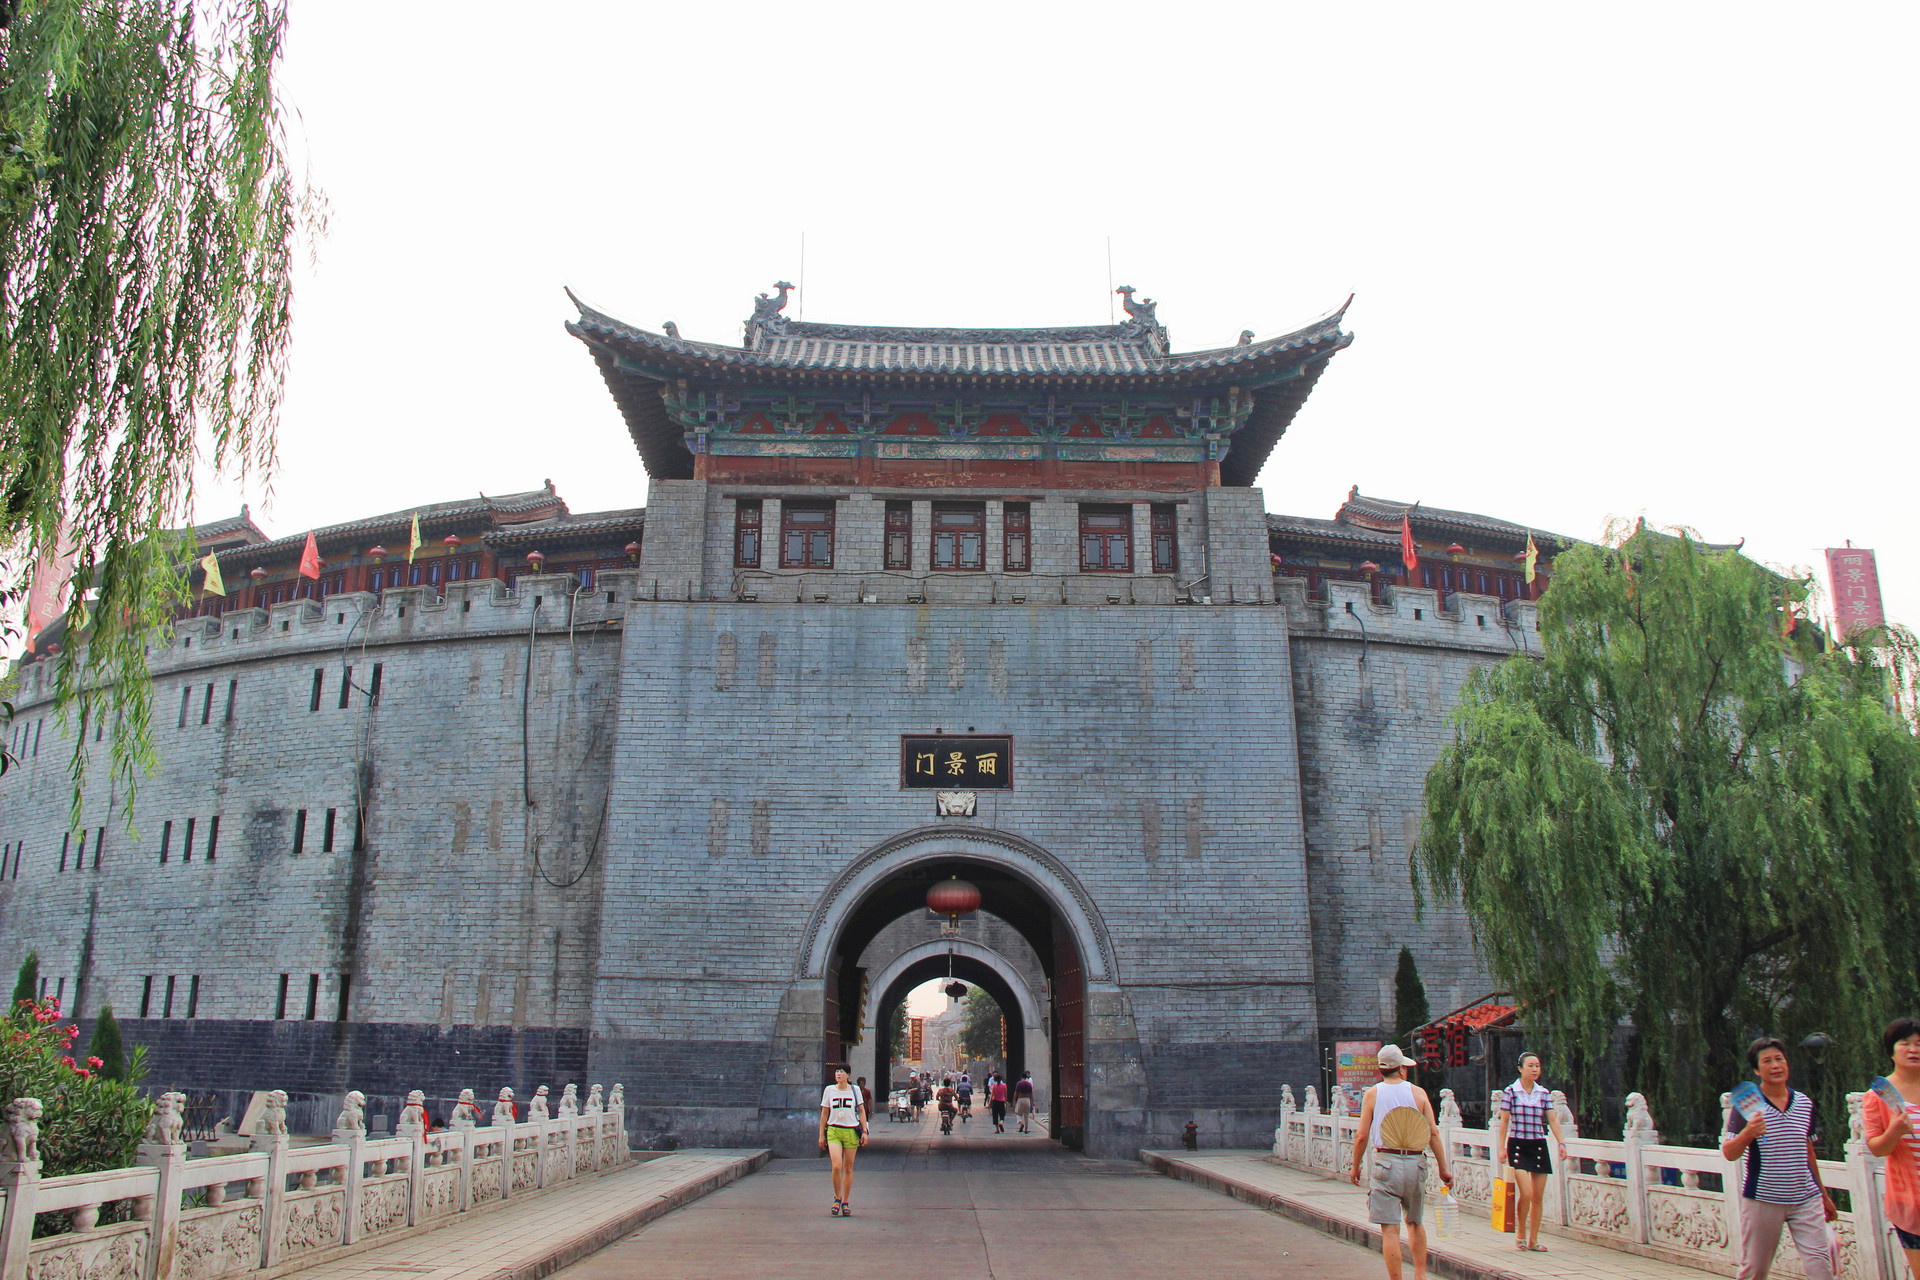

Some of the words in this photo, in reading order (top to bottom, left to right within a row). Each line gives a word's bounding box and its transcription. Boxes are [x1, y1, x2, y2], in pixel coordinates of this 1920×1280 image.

[916, 751, 998, 776] 丽景门
[1421, 1021, 1467, 1071] 宾馆
